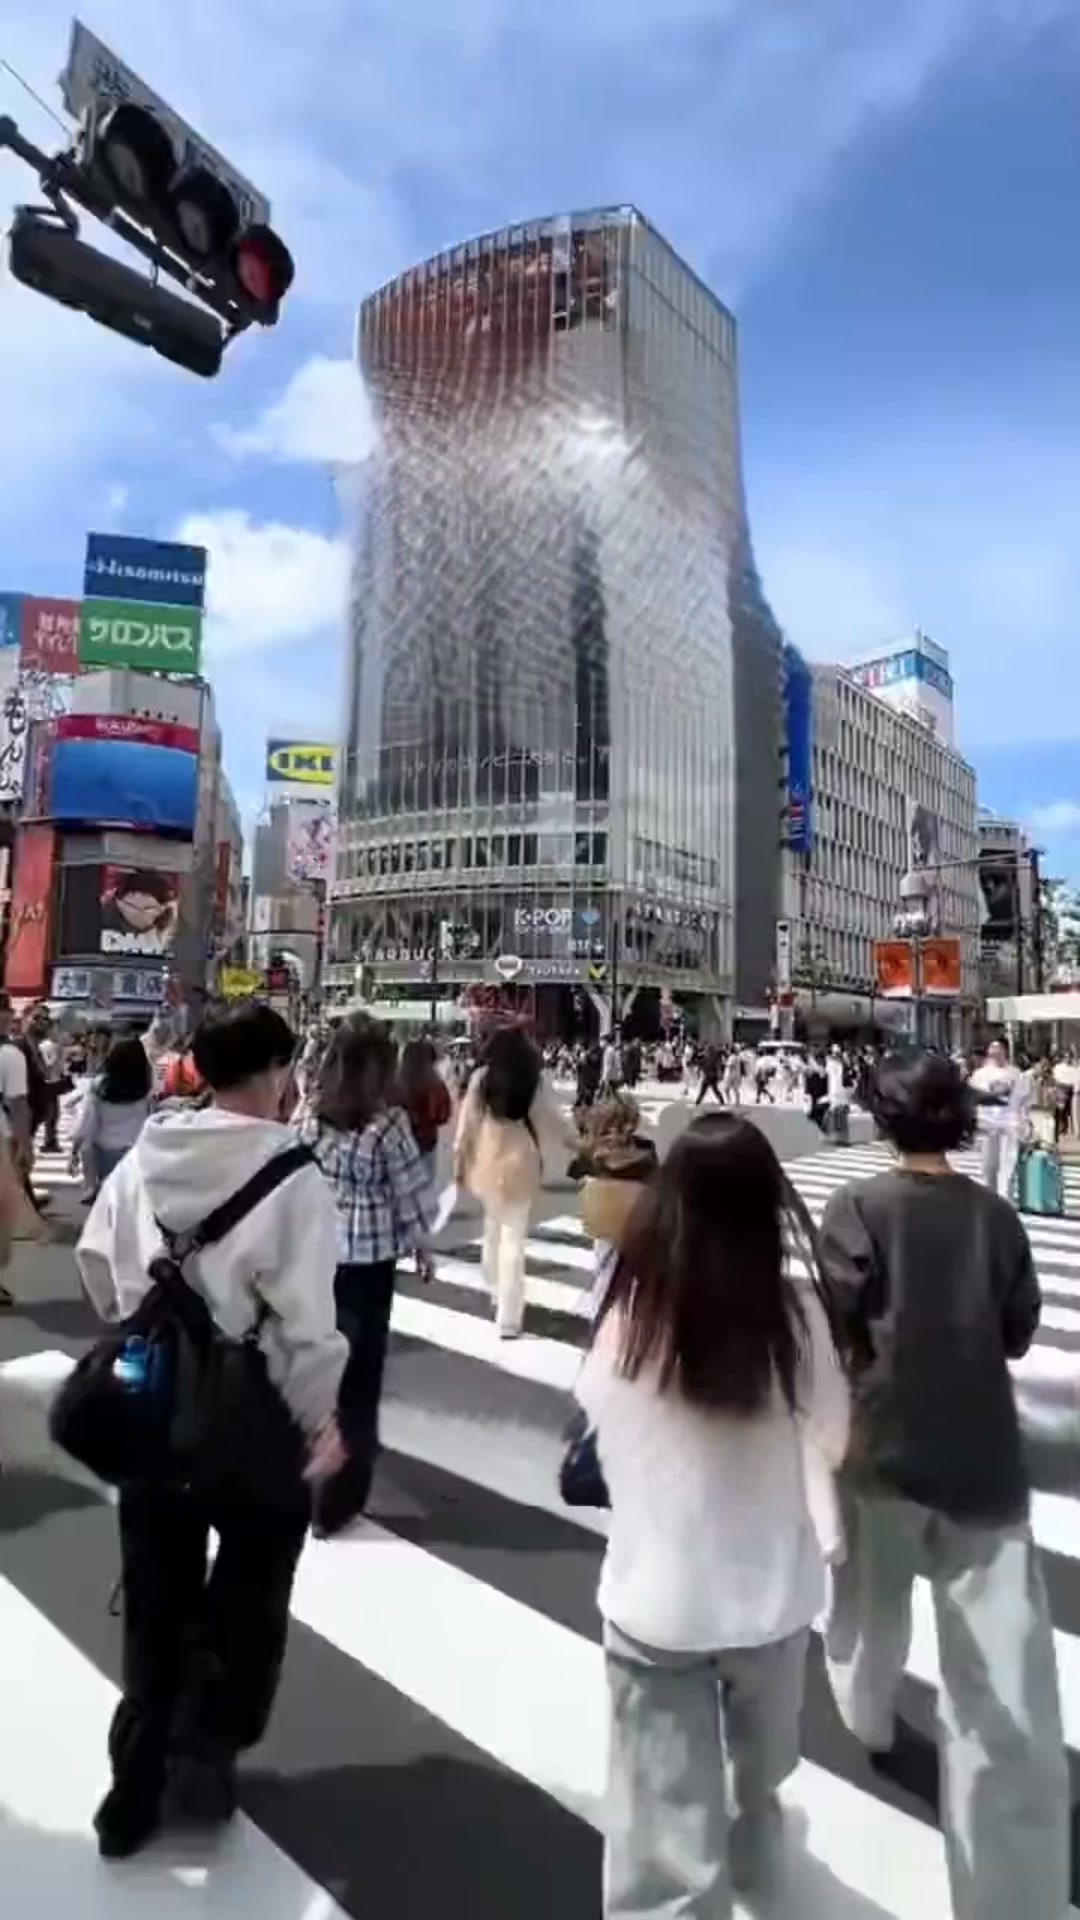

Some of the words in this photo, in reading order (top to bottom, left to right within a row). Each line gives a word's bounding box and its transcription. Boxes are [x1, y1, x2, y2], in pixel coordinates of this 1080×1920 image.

[88, 618, 193, 651] サロンパス
